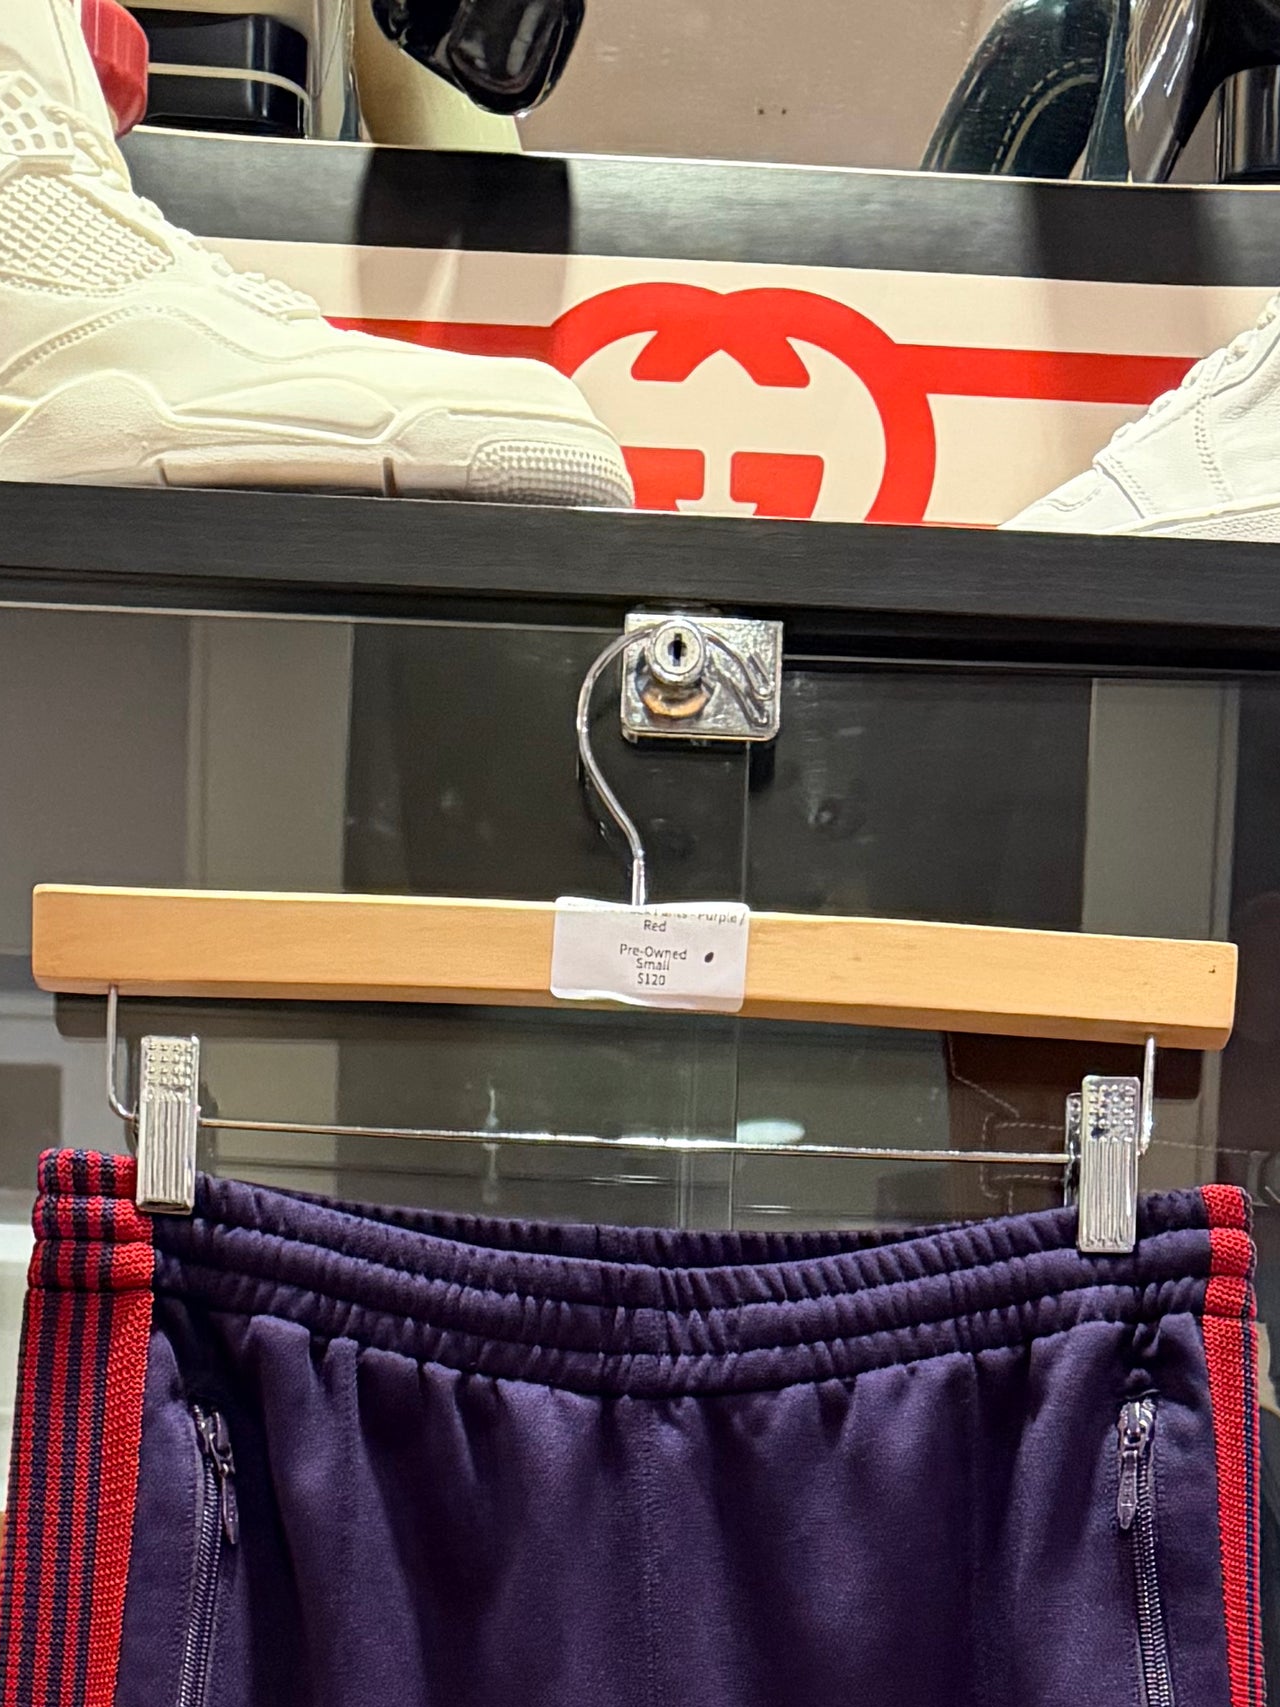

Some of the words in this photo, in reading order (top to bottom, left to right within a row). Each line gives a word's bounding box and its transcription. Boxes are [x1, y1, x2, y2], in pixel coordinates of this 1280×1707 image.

[643, 919, 667, 933] Red
[619, 943, 688, 961] Pre-Owned
[636, 957, 670, 971] Small
